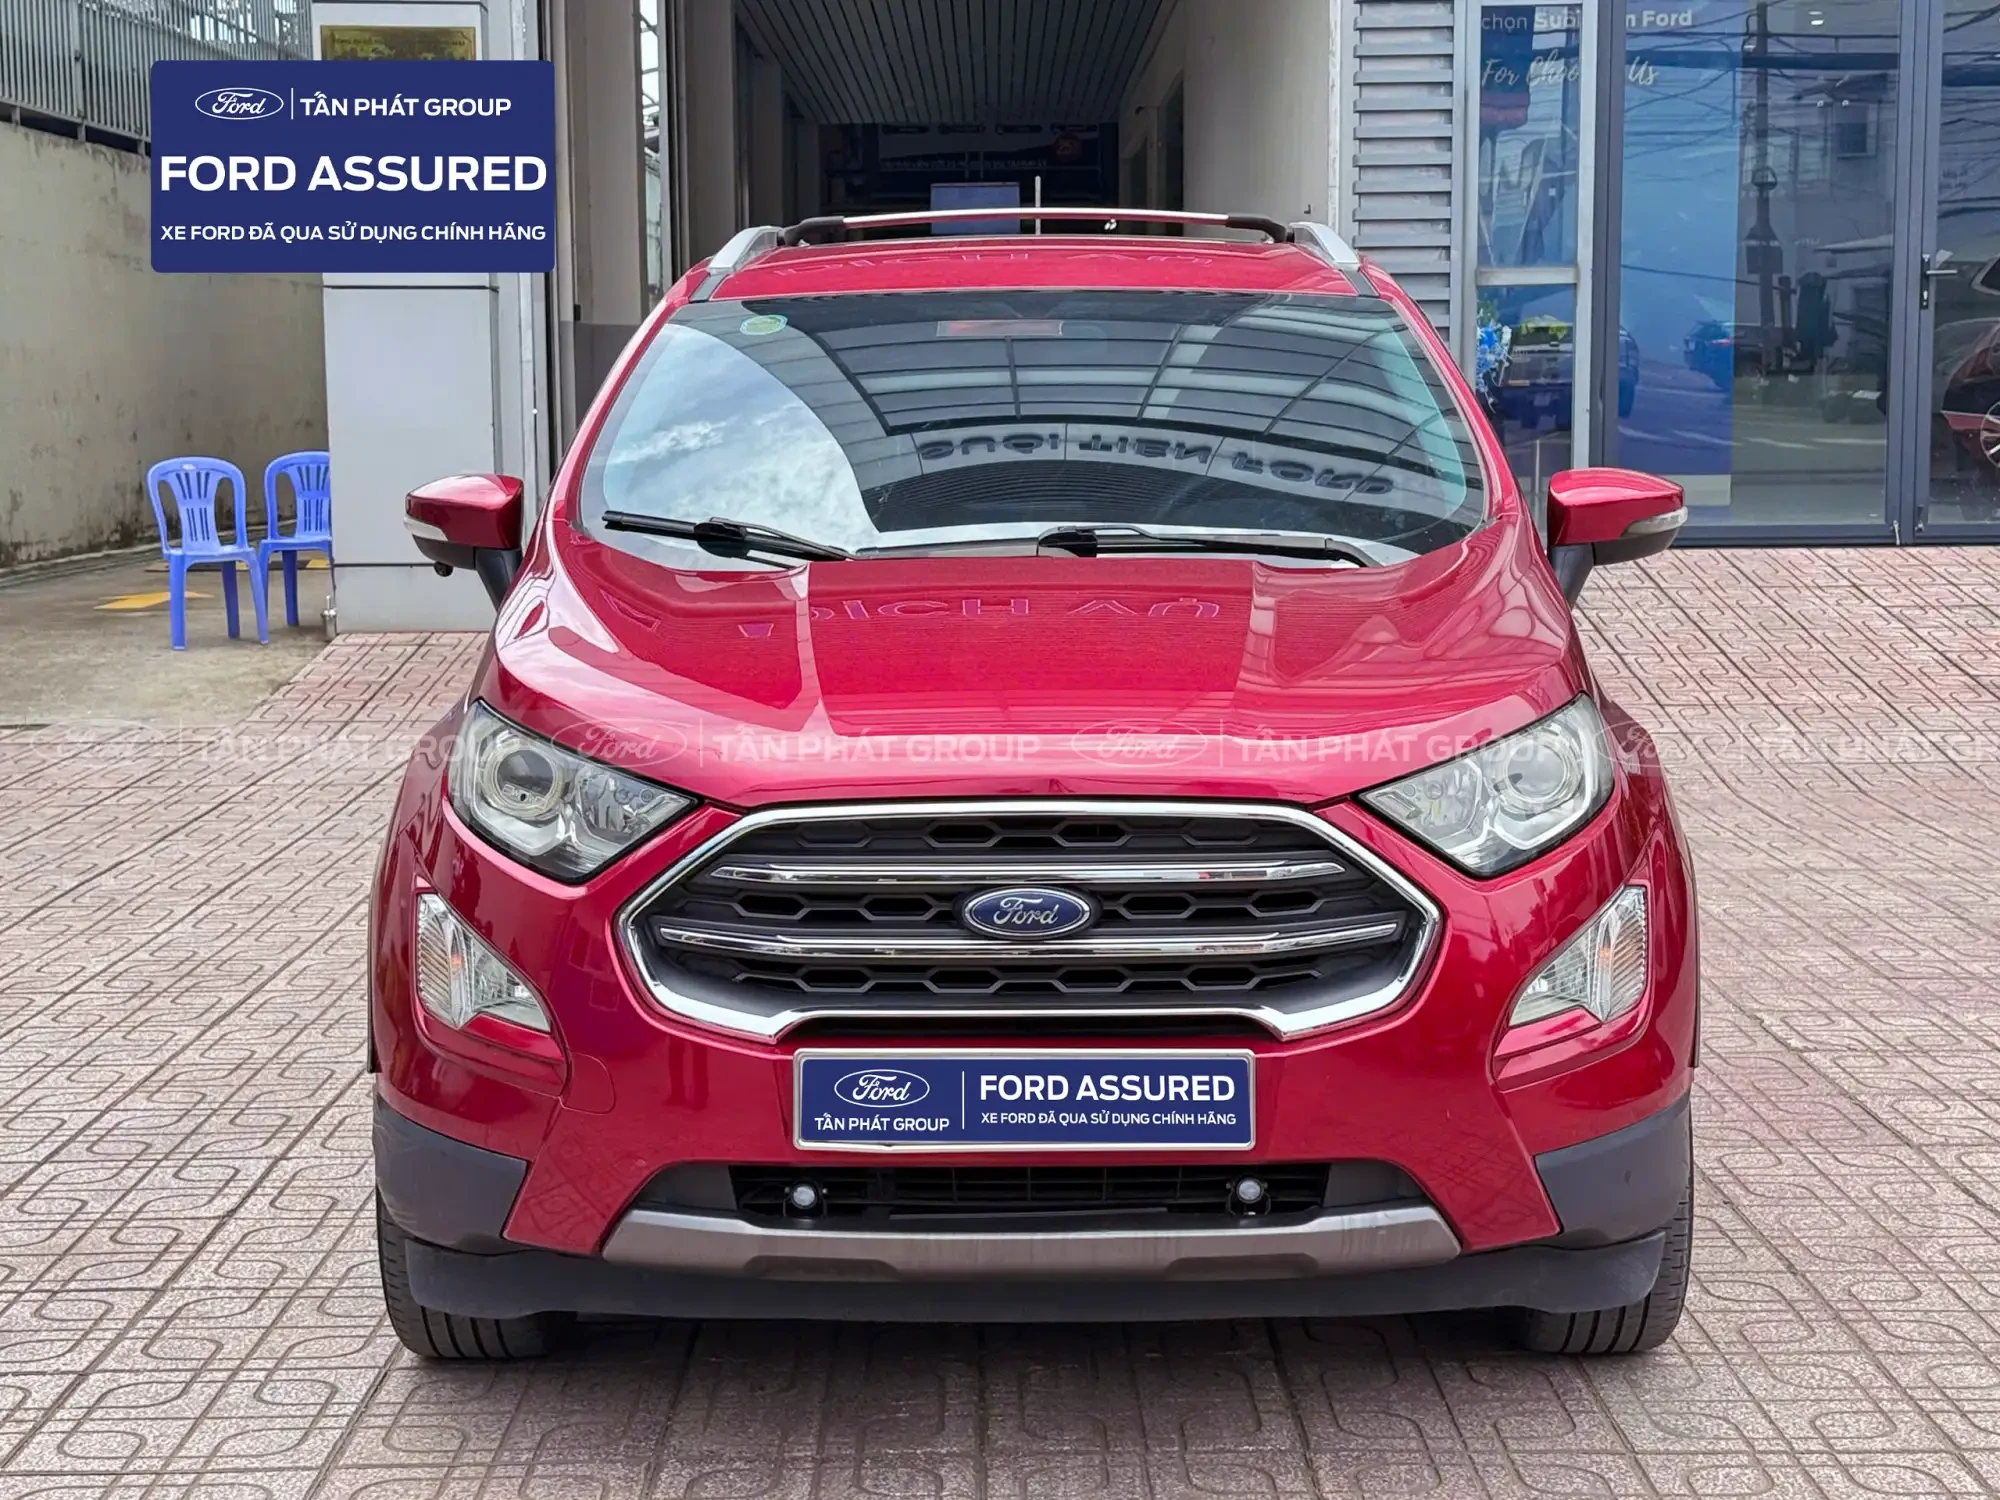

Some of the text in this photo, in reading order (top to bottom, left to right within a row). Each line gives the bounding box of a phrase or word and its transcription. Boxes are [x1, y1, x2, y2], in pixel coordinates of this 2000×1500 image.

[1642, 9, 1693, 28] Ford
[1482, 48, 1660, 87] For Choo Us
[993, 896, 1060, 925] Ford
